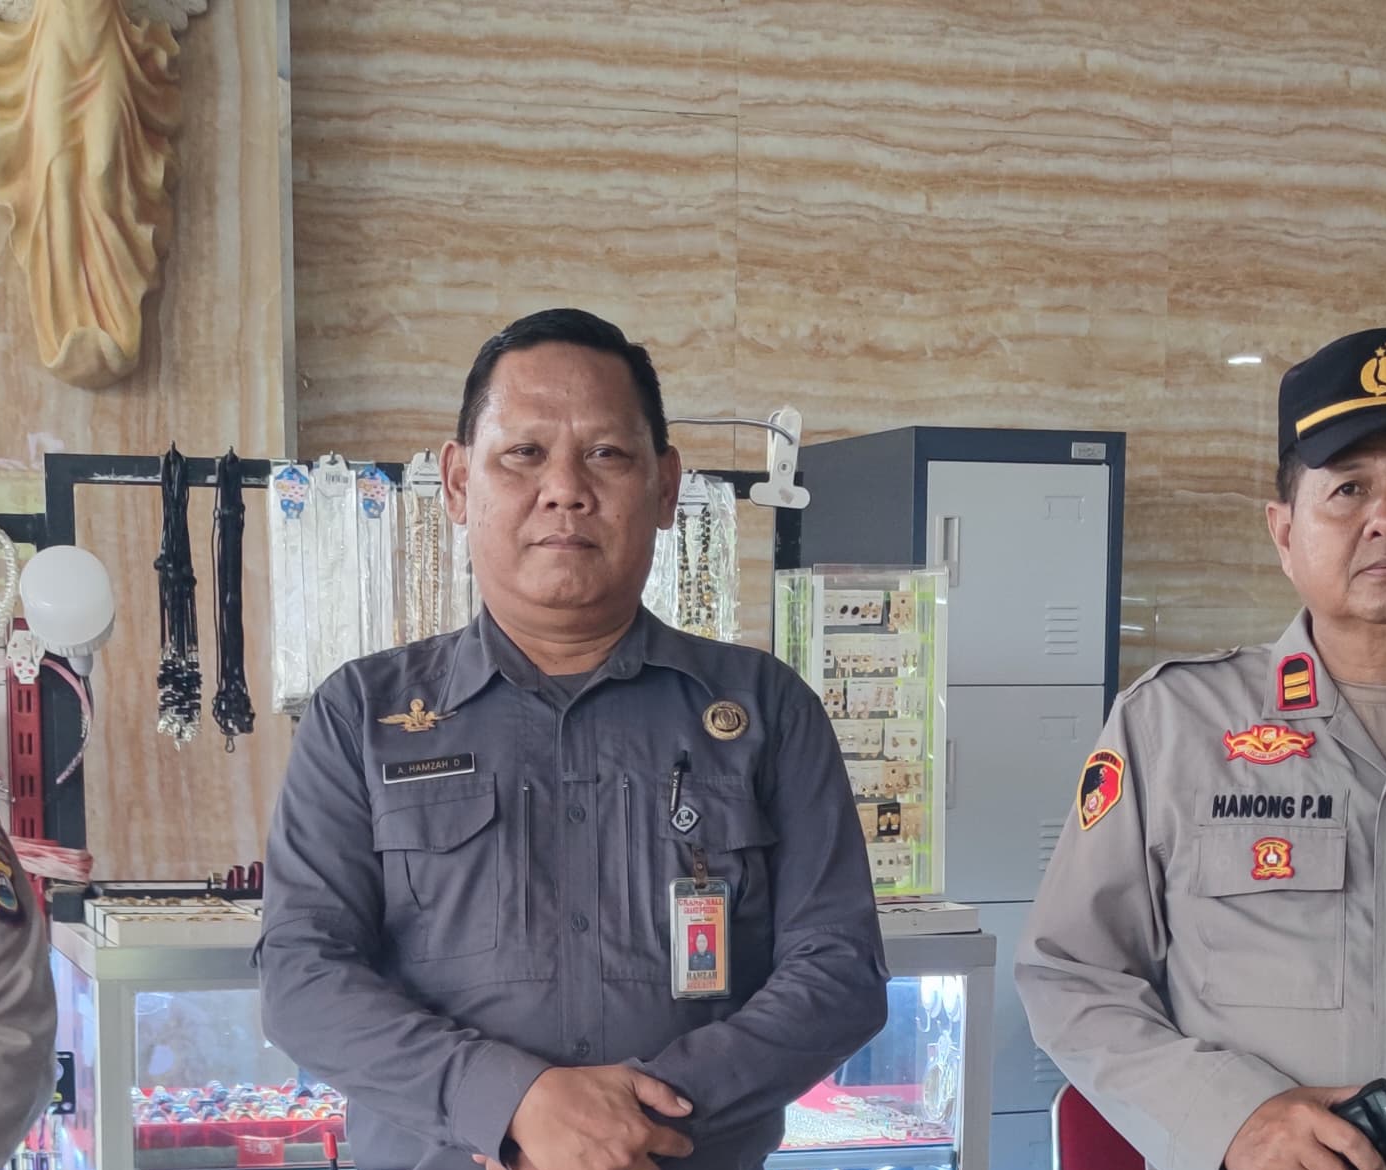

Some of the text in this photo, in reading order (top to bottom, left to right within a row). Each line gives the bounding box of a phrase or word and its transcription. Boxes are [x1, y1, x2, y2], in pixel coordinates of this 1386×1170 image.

[408, 760, 449, 773] HAMZAH
[1211, 794, 1333, 819] HANONG P.M
